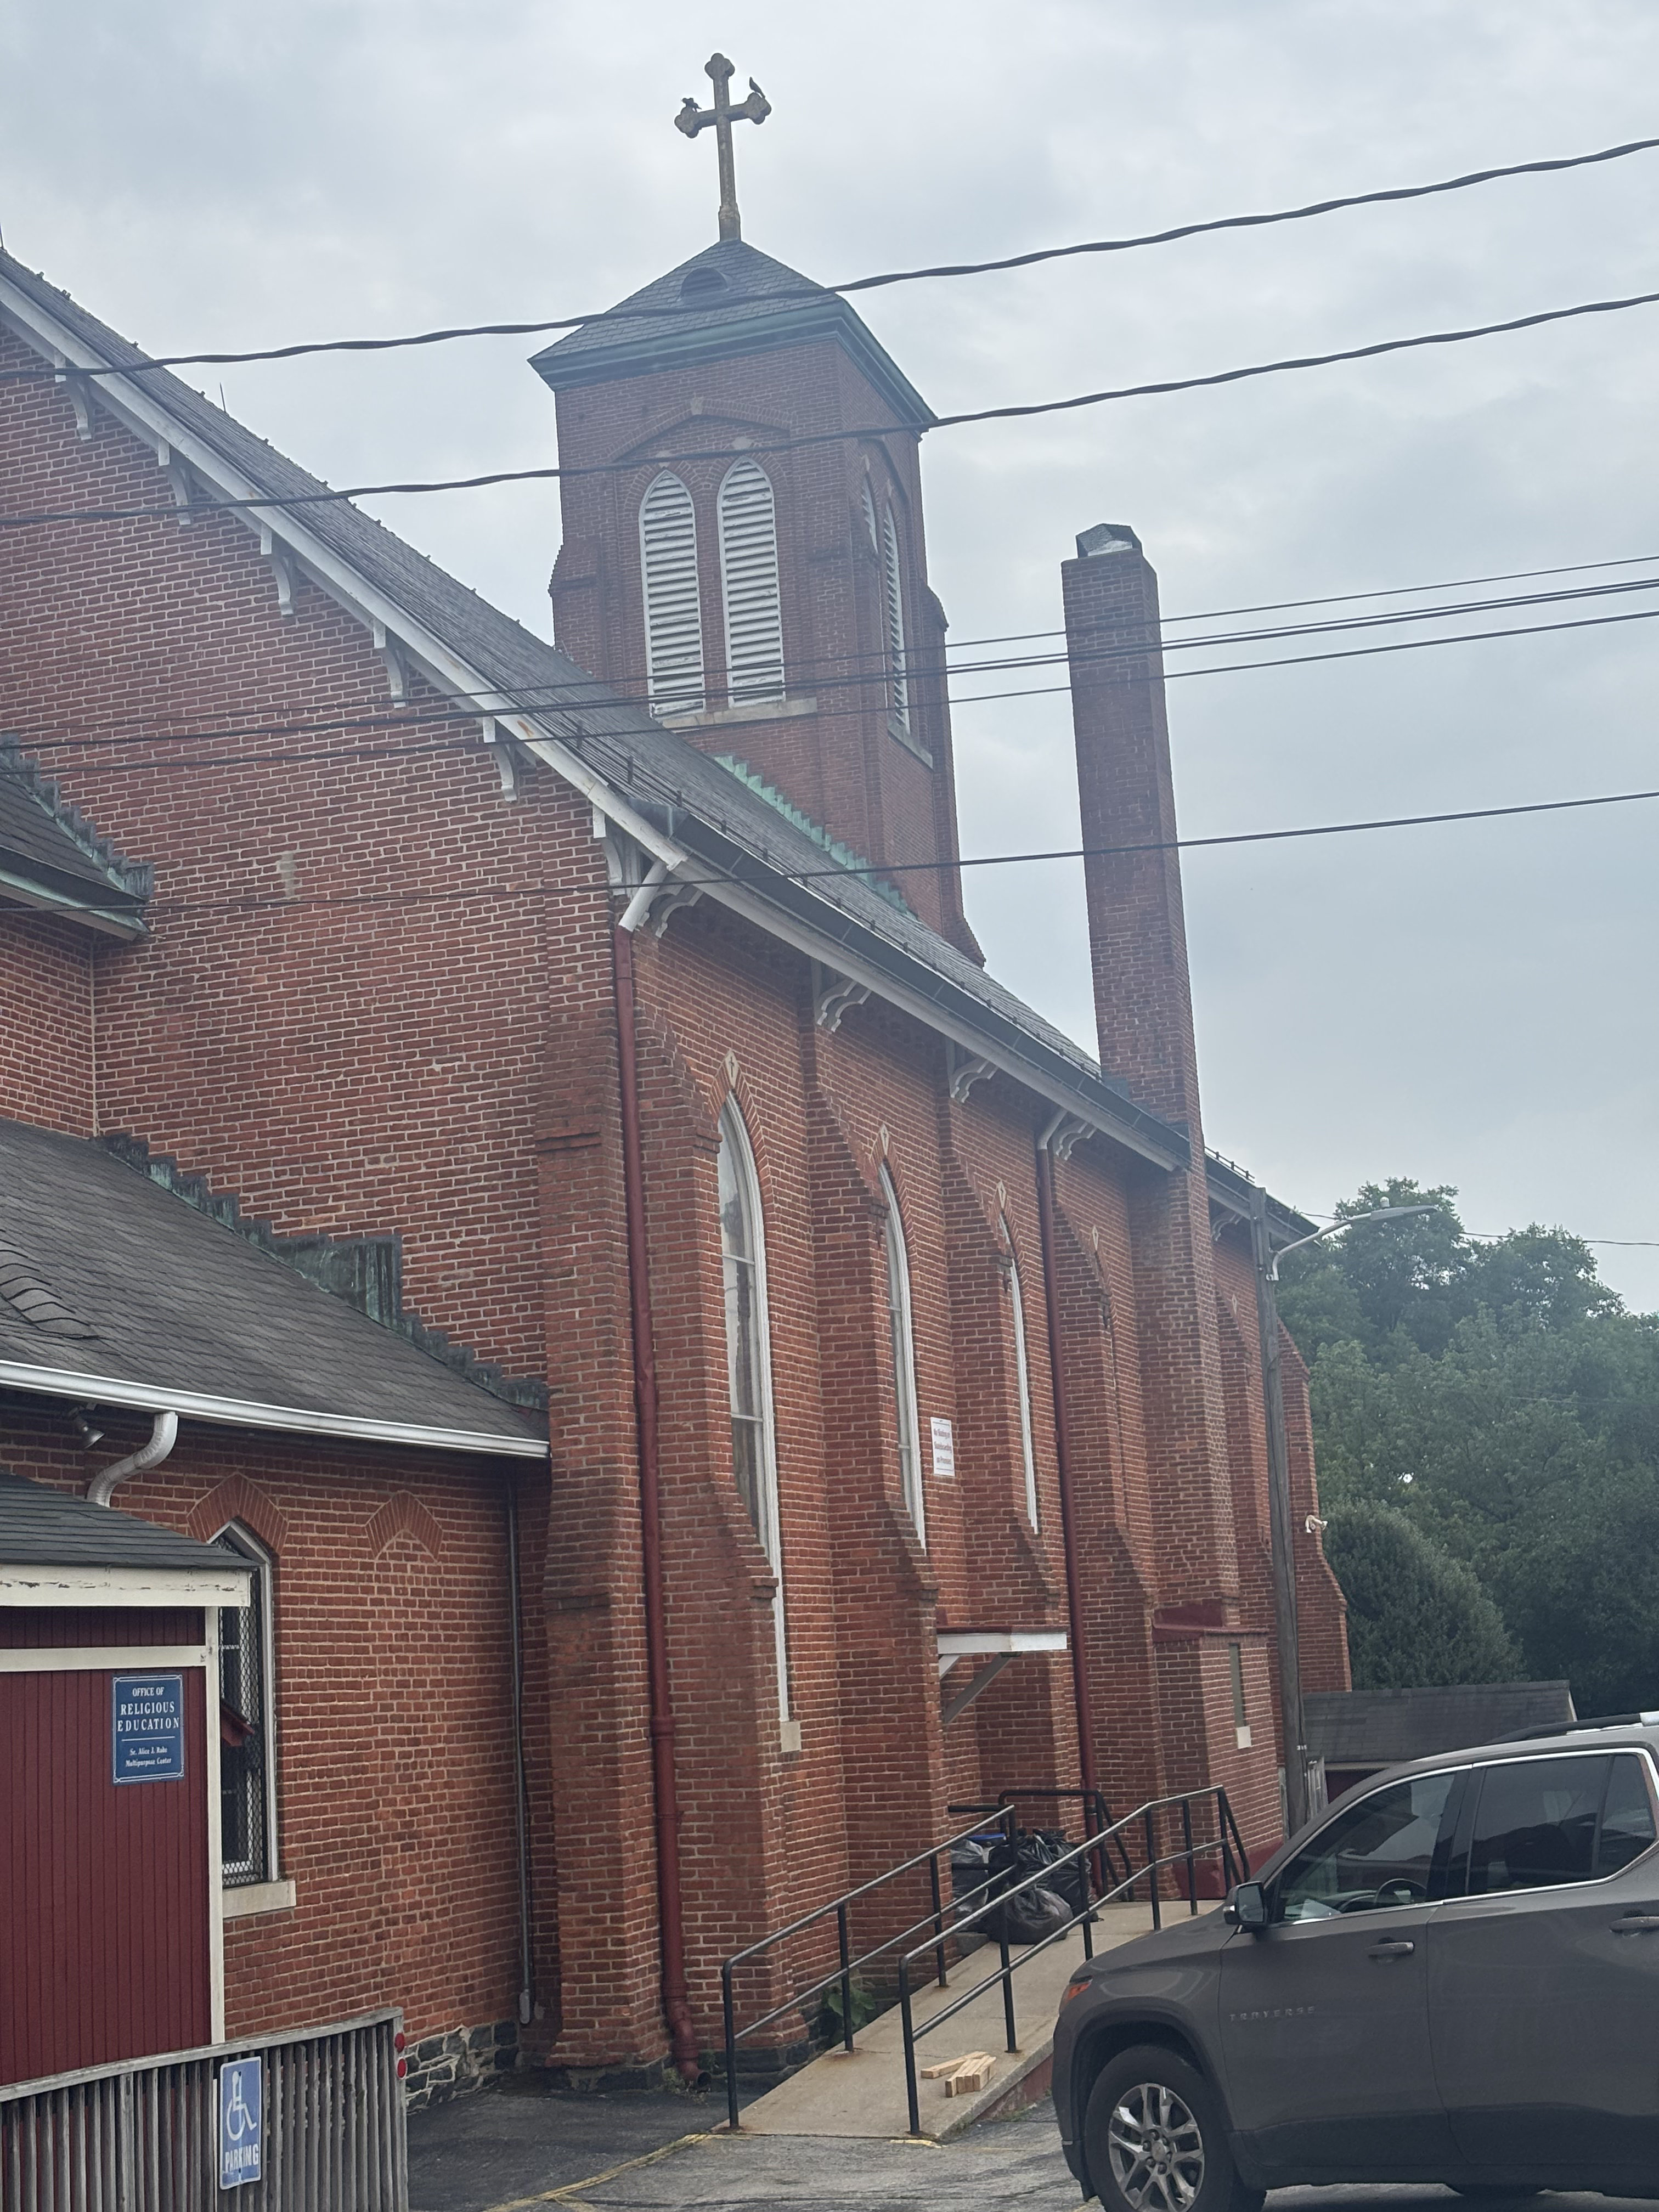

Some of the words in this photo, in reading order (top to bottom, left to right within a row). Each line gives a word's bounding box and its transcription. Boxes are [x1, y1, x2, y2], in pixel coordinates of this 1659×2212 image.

[132, 1687, 154, 1697] OFFICE
[156, 1686, 165, 1696] OF
[120, 1701, 174, 1716] RELIGIOUS
[117, 1717, 179, 1732] EDUCATION
[1229, 2006, 1315, 2022] TRAVERSE
[225, 2143, 259, 2173] PARKING
